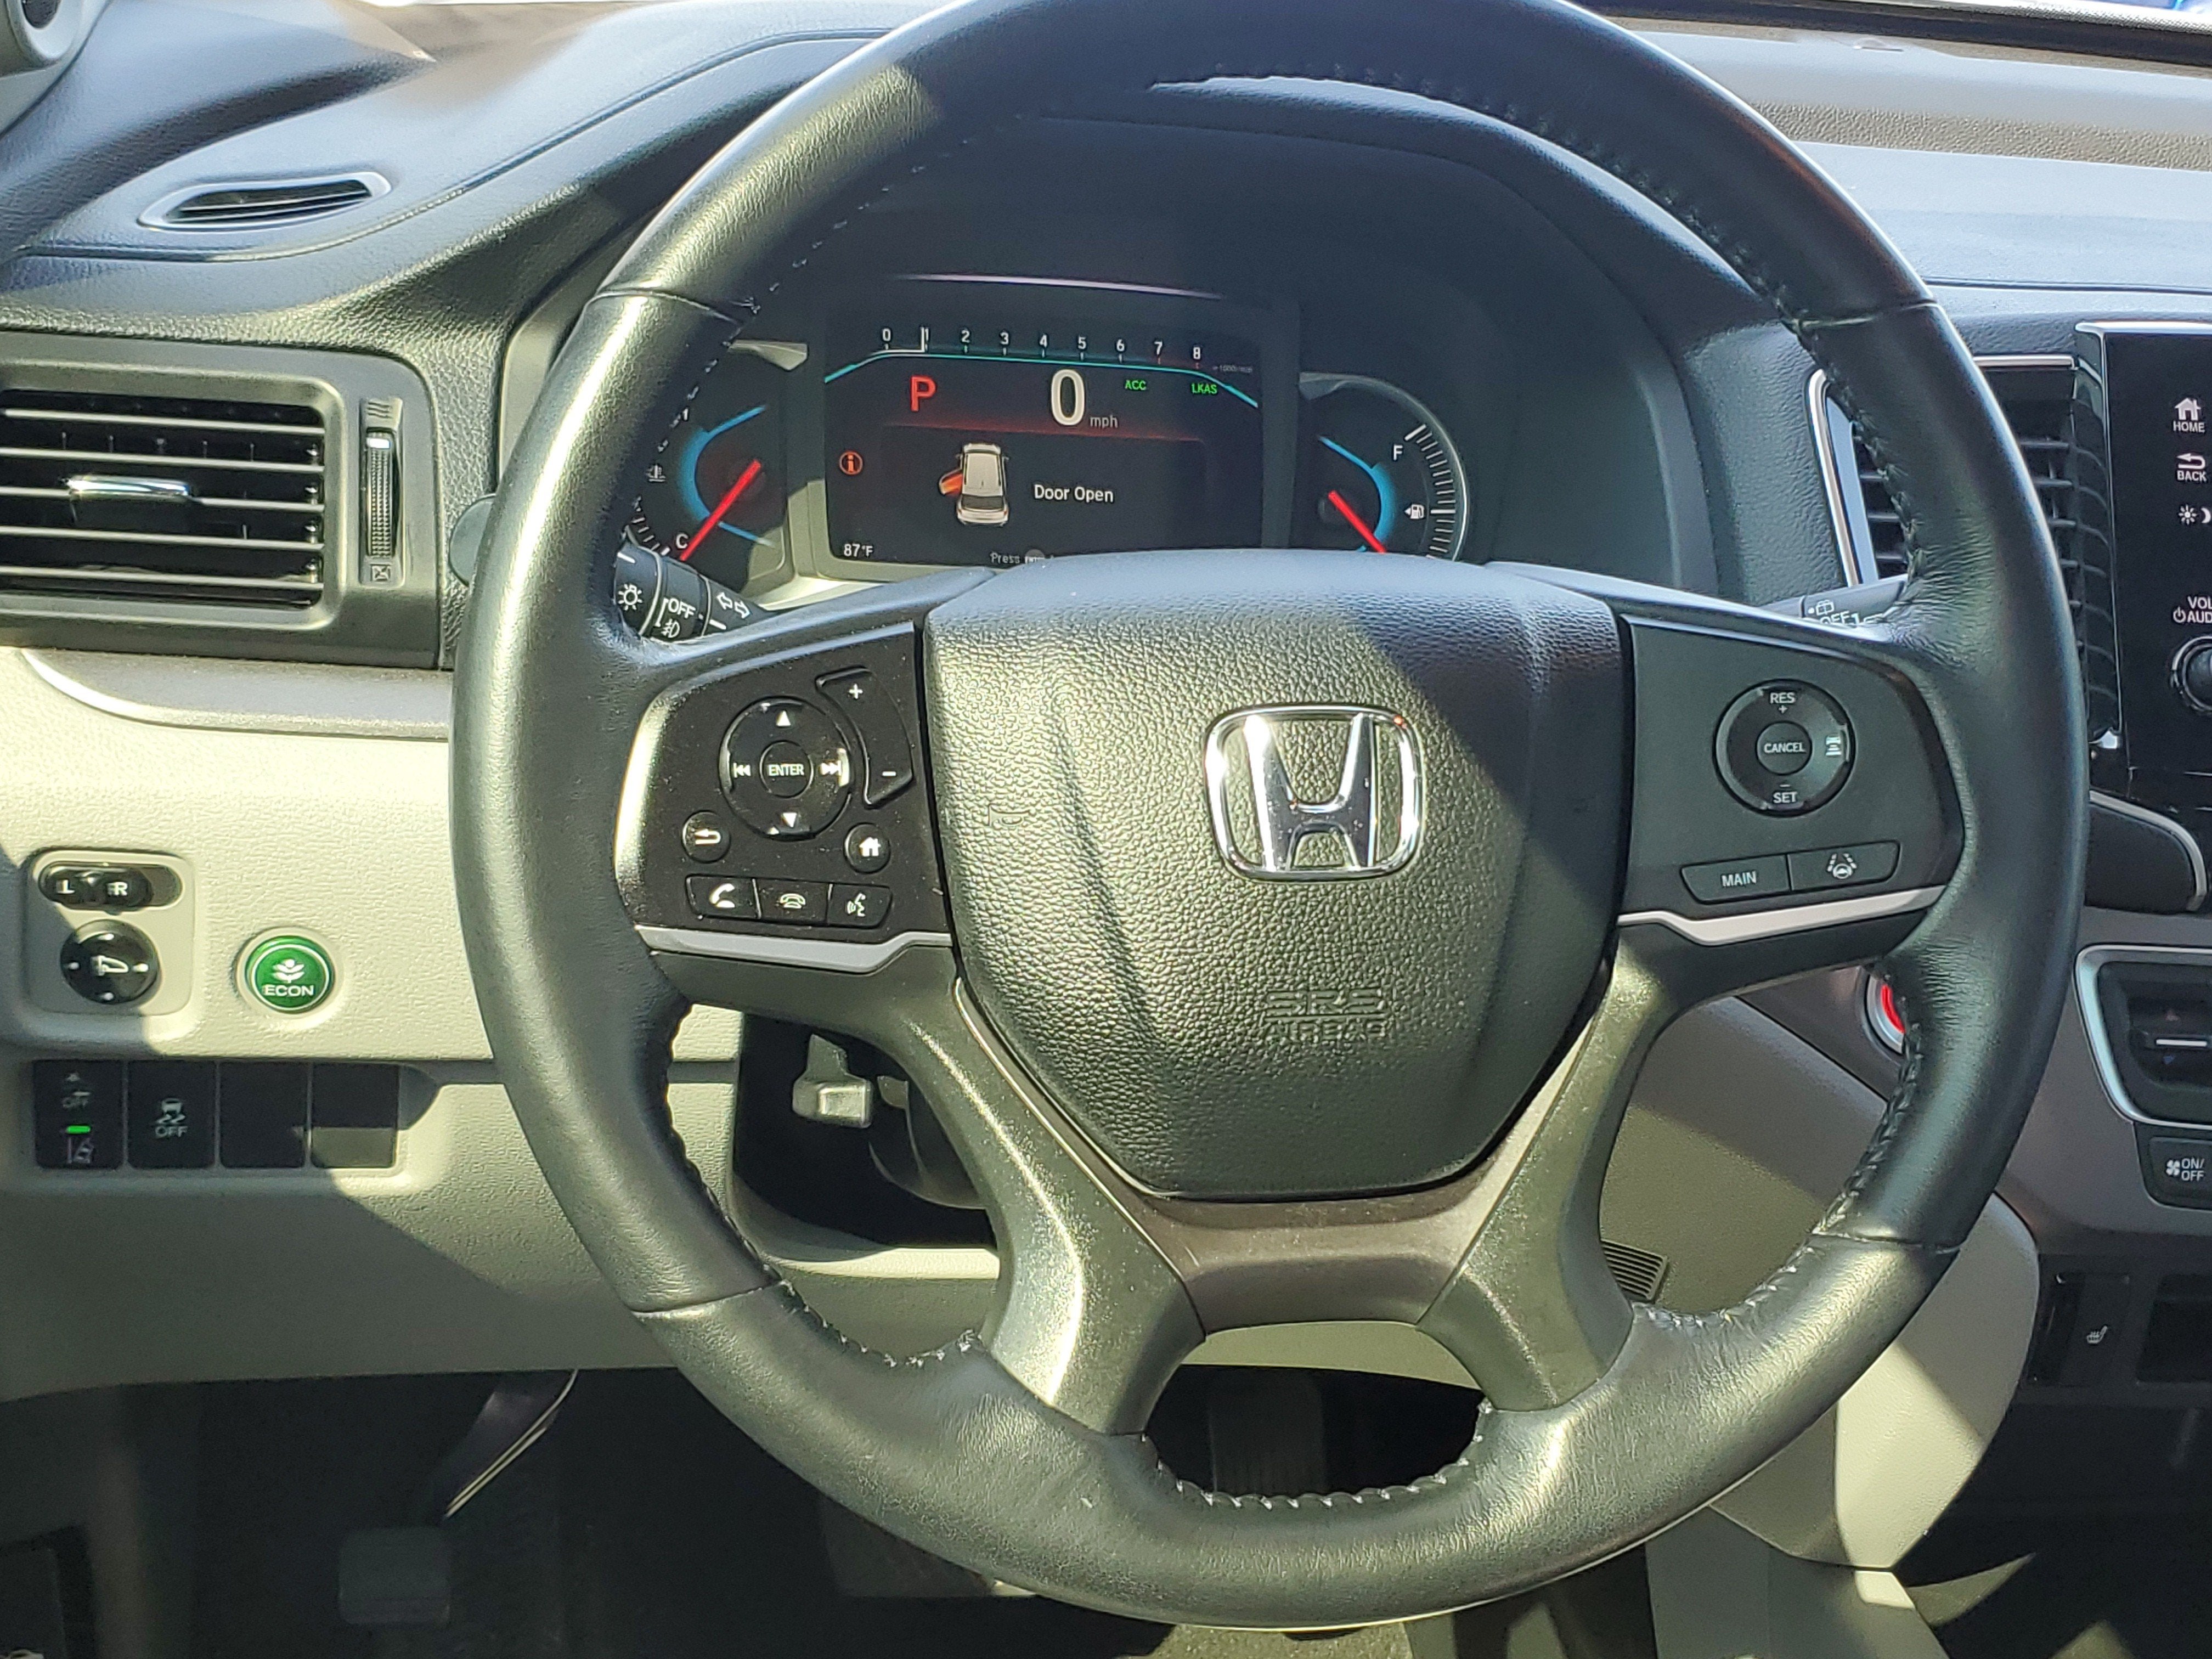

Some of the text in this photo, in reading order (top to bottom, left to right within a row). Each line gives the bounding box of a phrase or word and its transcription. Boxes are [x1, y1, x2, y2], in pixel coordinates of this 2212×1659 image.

[882, 328, 891, 342] 0
[961, 329, 970, 343] 2
[1000, 331, 1009, 345] 3
[1039, 334, 1047, 347] 4
[1077, 336, 1087, 350] 5
[1116, 339, 1125, 352] 6
[1154, 341, 1163, 355] 7
[1193, 346, 1201, 360] 8
[1125, 380, 1147, 391] ACC
[1191, 382, 1218, 395] LKAS
[910, 375, 936, 411] P
[1051, 368, 1119, 428] 0 mph
[2172, 421, 2205, 433] HOME
[1393, 444, 1403, 461] F
[2176, 471, 2207, 482] BACK
[1034, 484, 1114, 503] Door Open
[675, 533, 689, 549] C
[990, 551, 1020, 564] Press
[668, 597, 696, 618] OFF
[2187, 595, 2212, 610] VOL
[1770, 692, 1796, 704] RES
[1763, 742, 1806, 754] CANCEL
[768, 764, 805, 777] ENTER
[1773, 791, 1798, 804] SET
[1721, 871, 1757, 888] MAIN
[58, 879, 128, 896] L R
[264, 984, 314, 998] ECON
[154, 1125, 189, 1138] OFF
[2181, 1170, 2205, 1182] OFF
